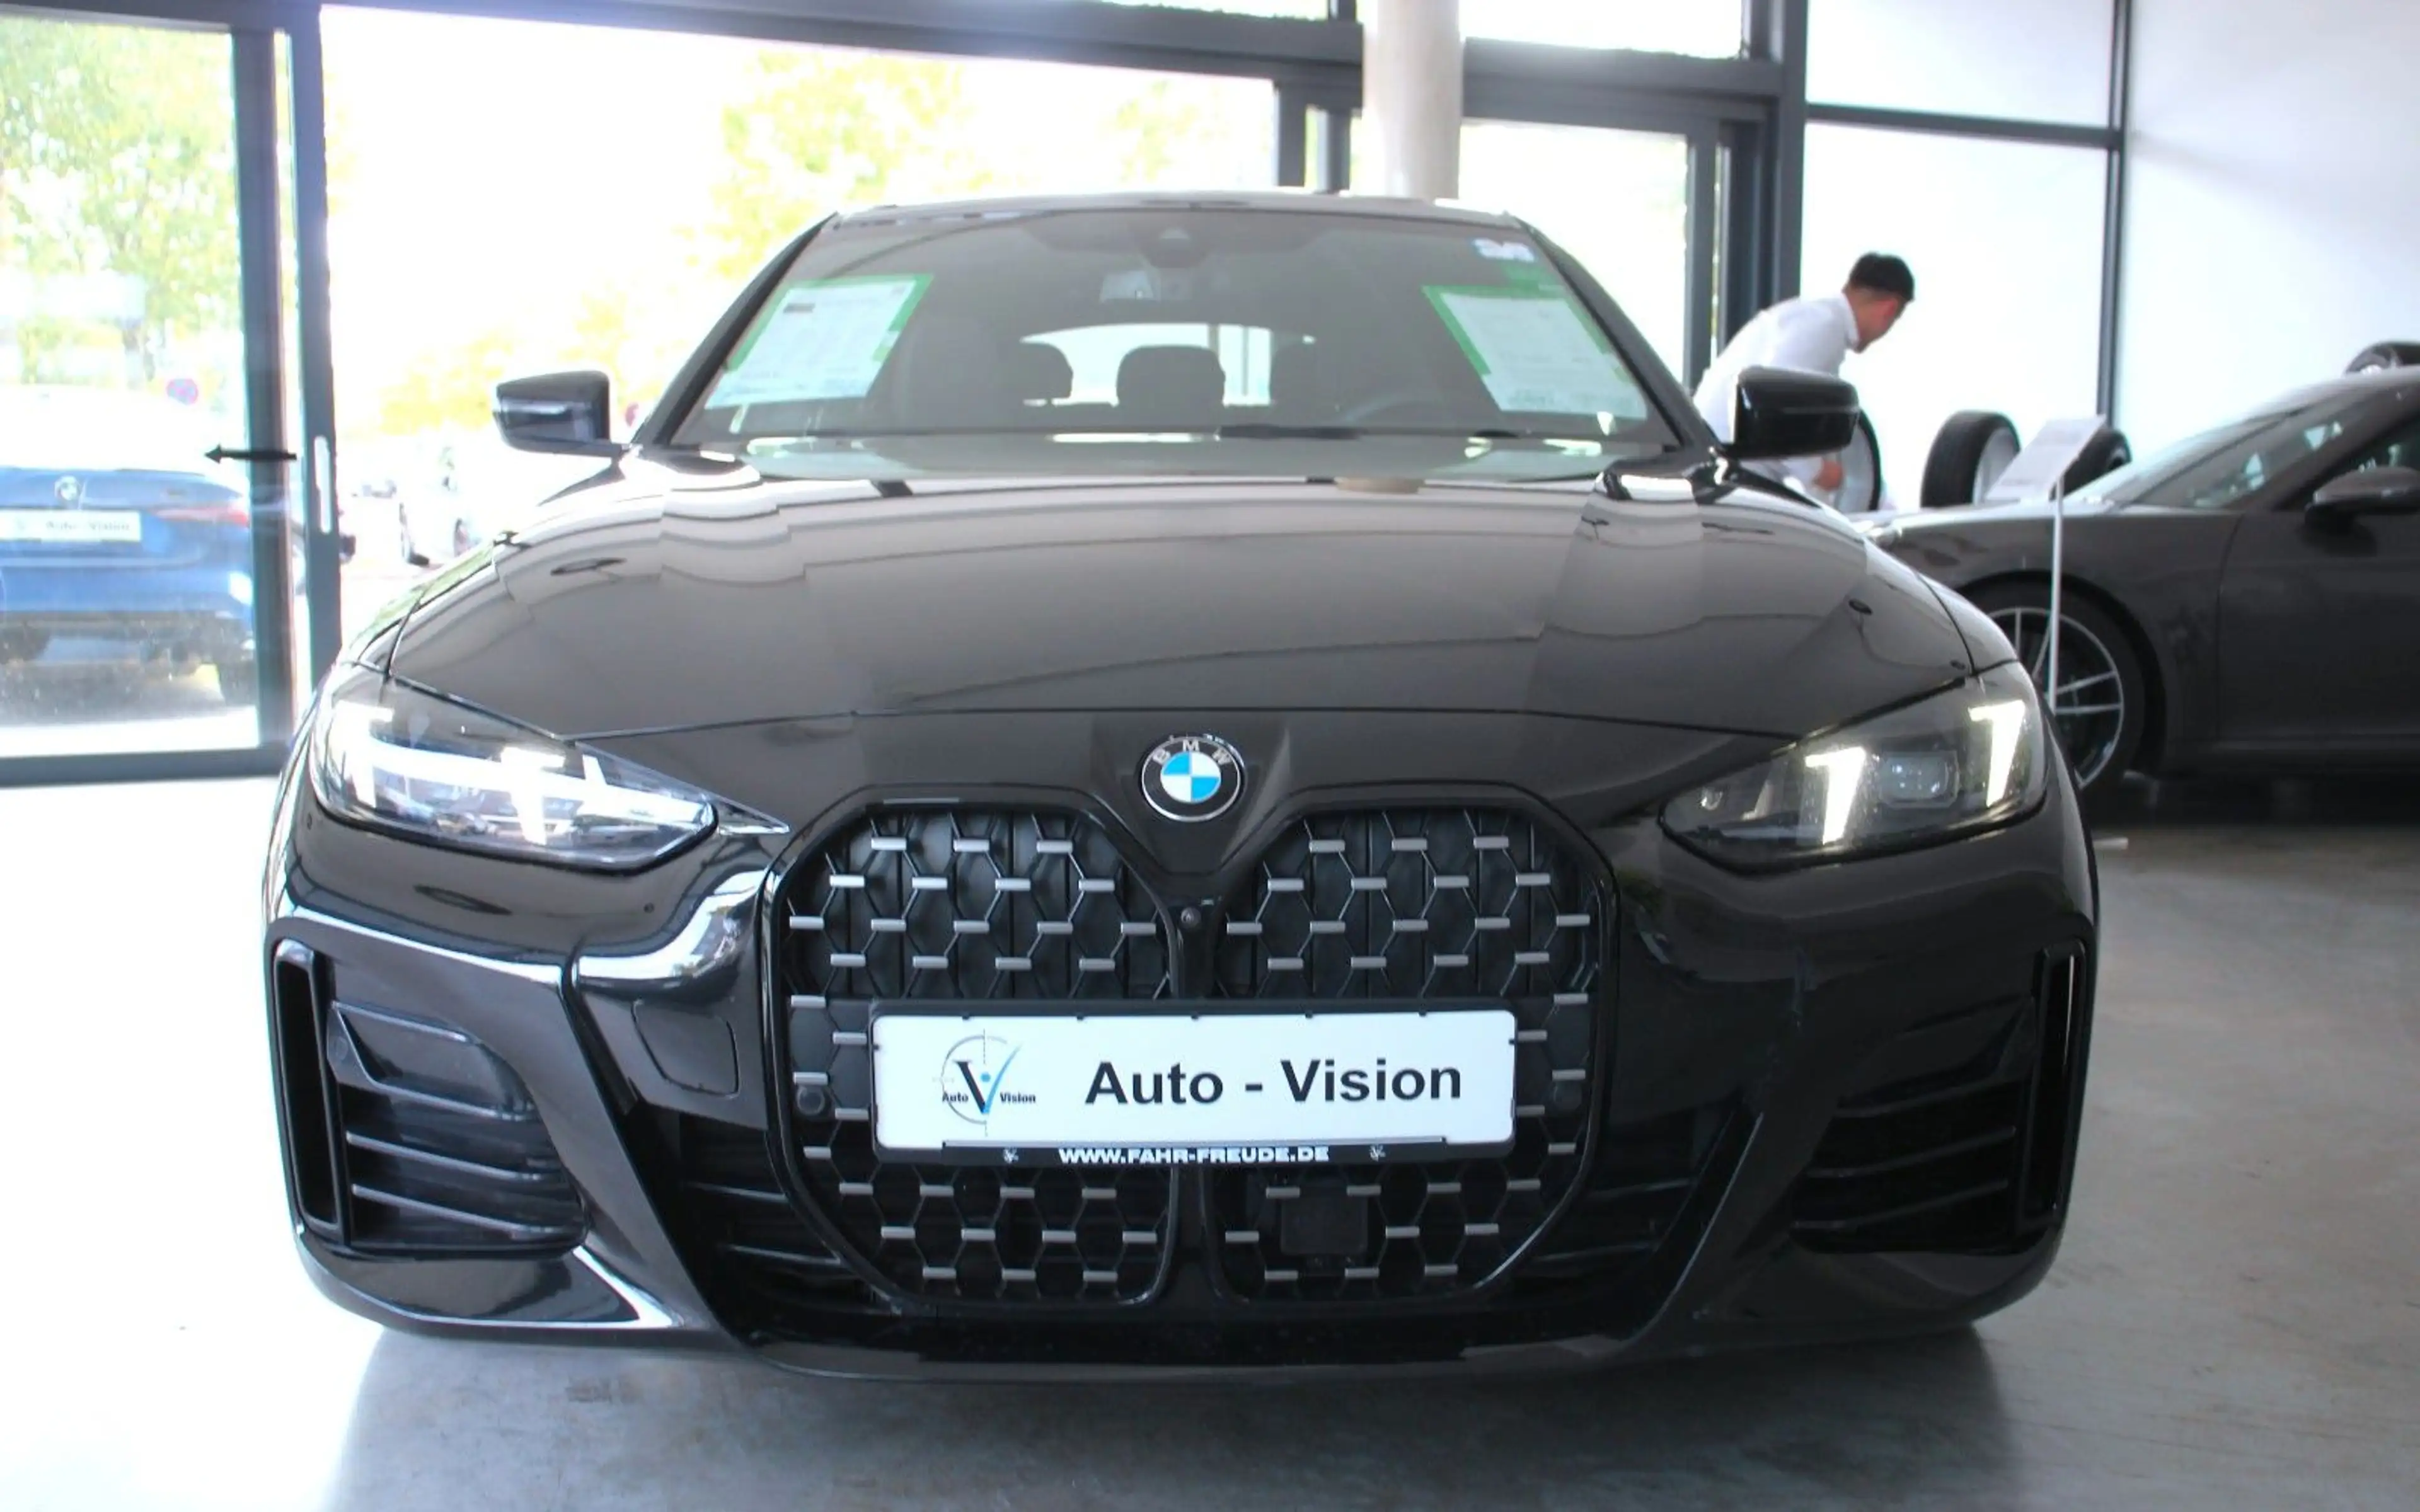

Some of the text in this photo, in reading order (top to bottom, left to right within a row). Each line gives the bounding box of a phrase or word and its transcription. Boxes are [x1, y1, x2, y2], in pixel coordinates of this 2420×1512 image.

[1153, 739, 1231, 765] BMW
[1085, 1062, 1224, 1105] Auto
[1280, 1058, 1461, 1102] Vision
[942, 1091, 1037, 1103] Auto Vision
[1059, 1146, 1330, 1164] WWW.FAHR-FREUDE.DE
